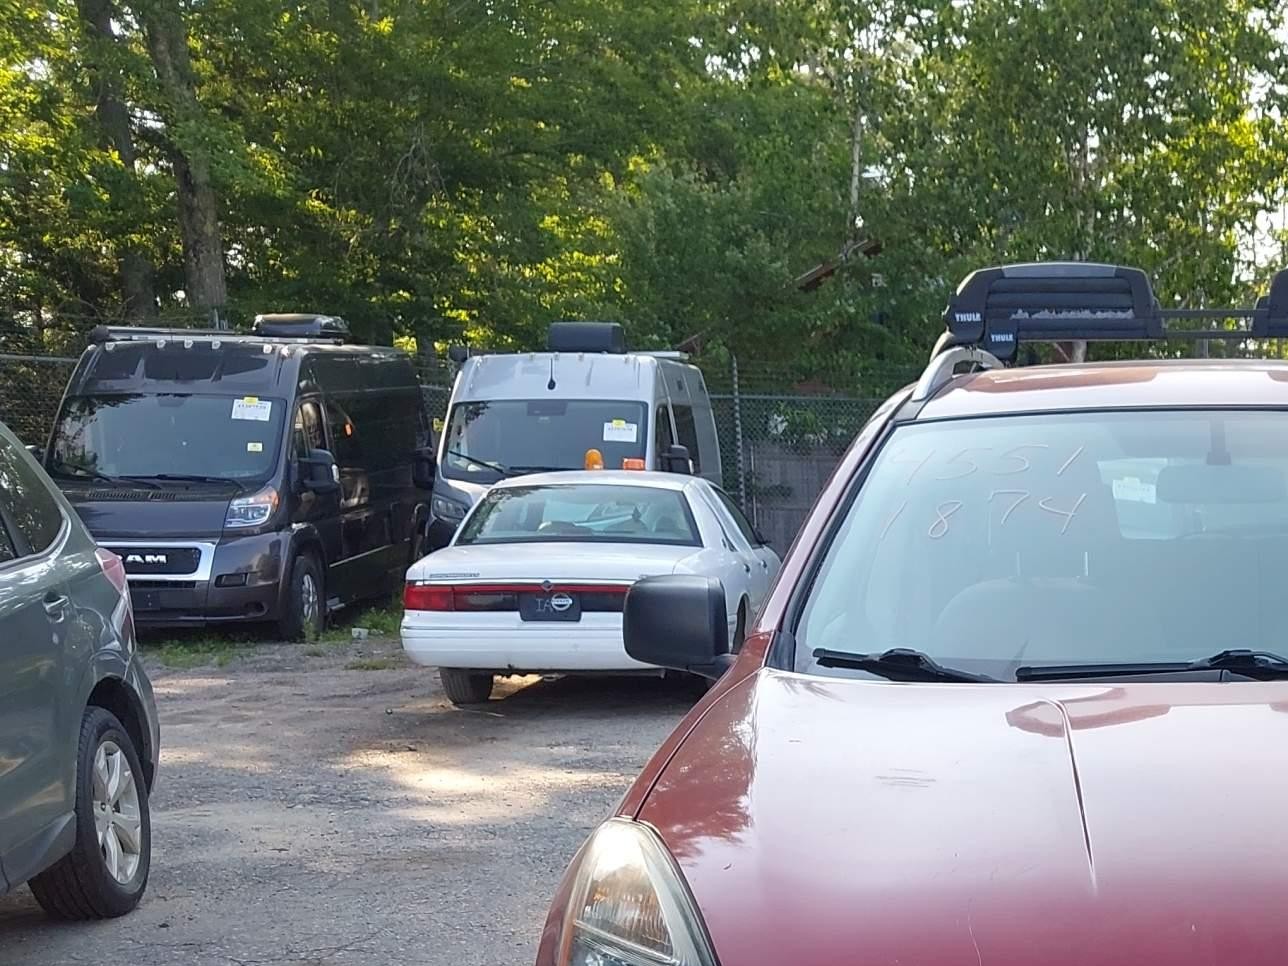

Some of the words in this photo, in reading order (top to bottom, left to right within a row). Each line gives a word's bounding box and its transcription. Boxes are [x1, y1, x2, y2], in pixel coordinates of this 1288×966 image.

[955, 313, 981, 322] THULE
[991, 333, 1013, 342] THULE
[880, 489, 1087, 541] 1874
[121, 554, 167, 564] AM
